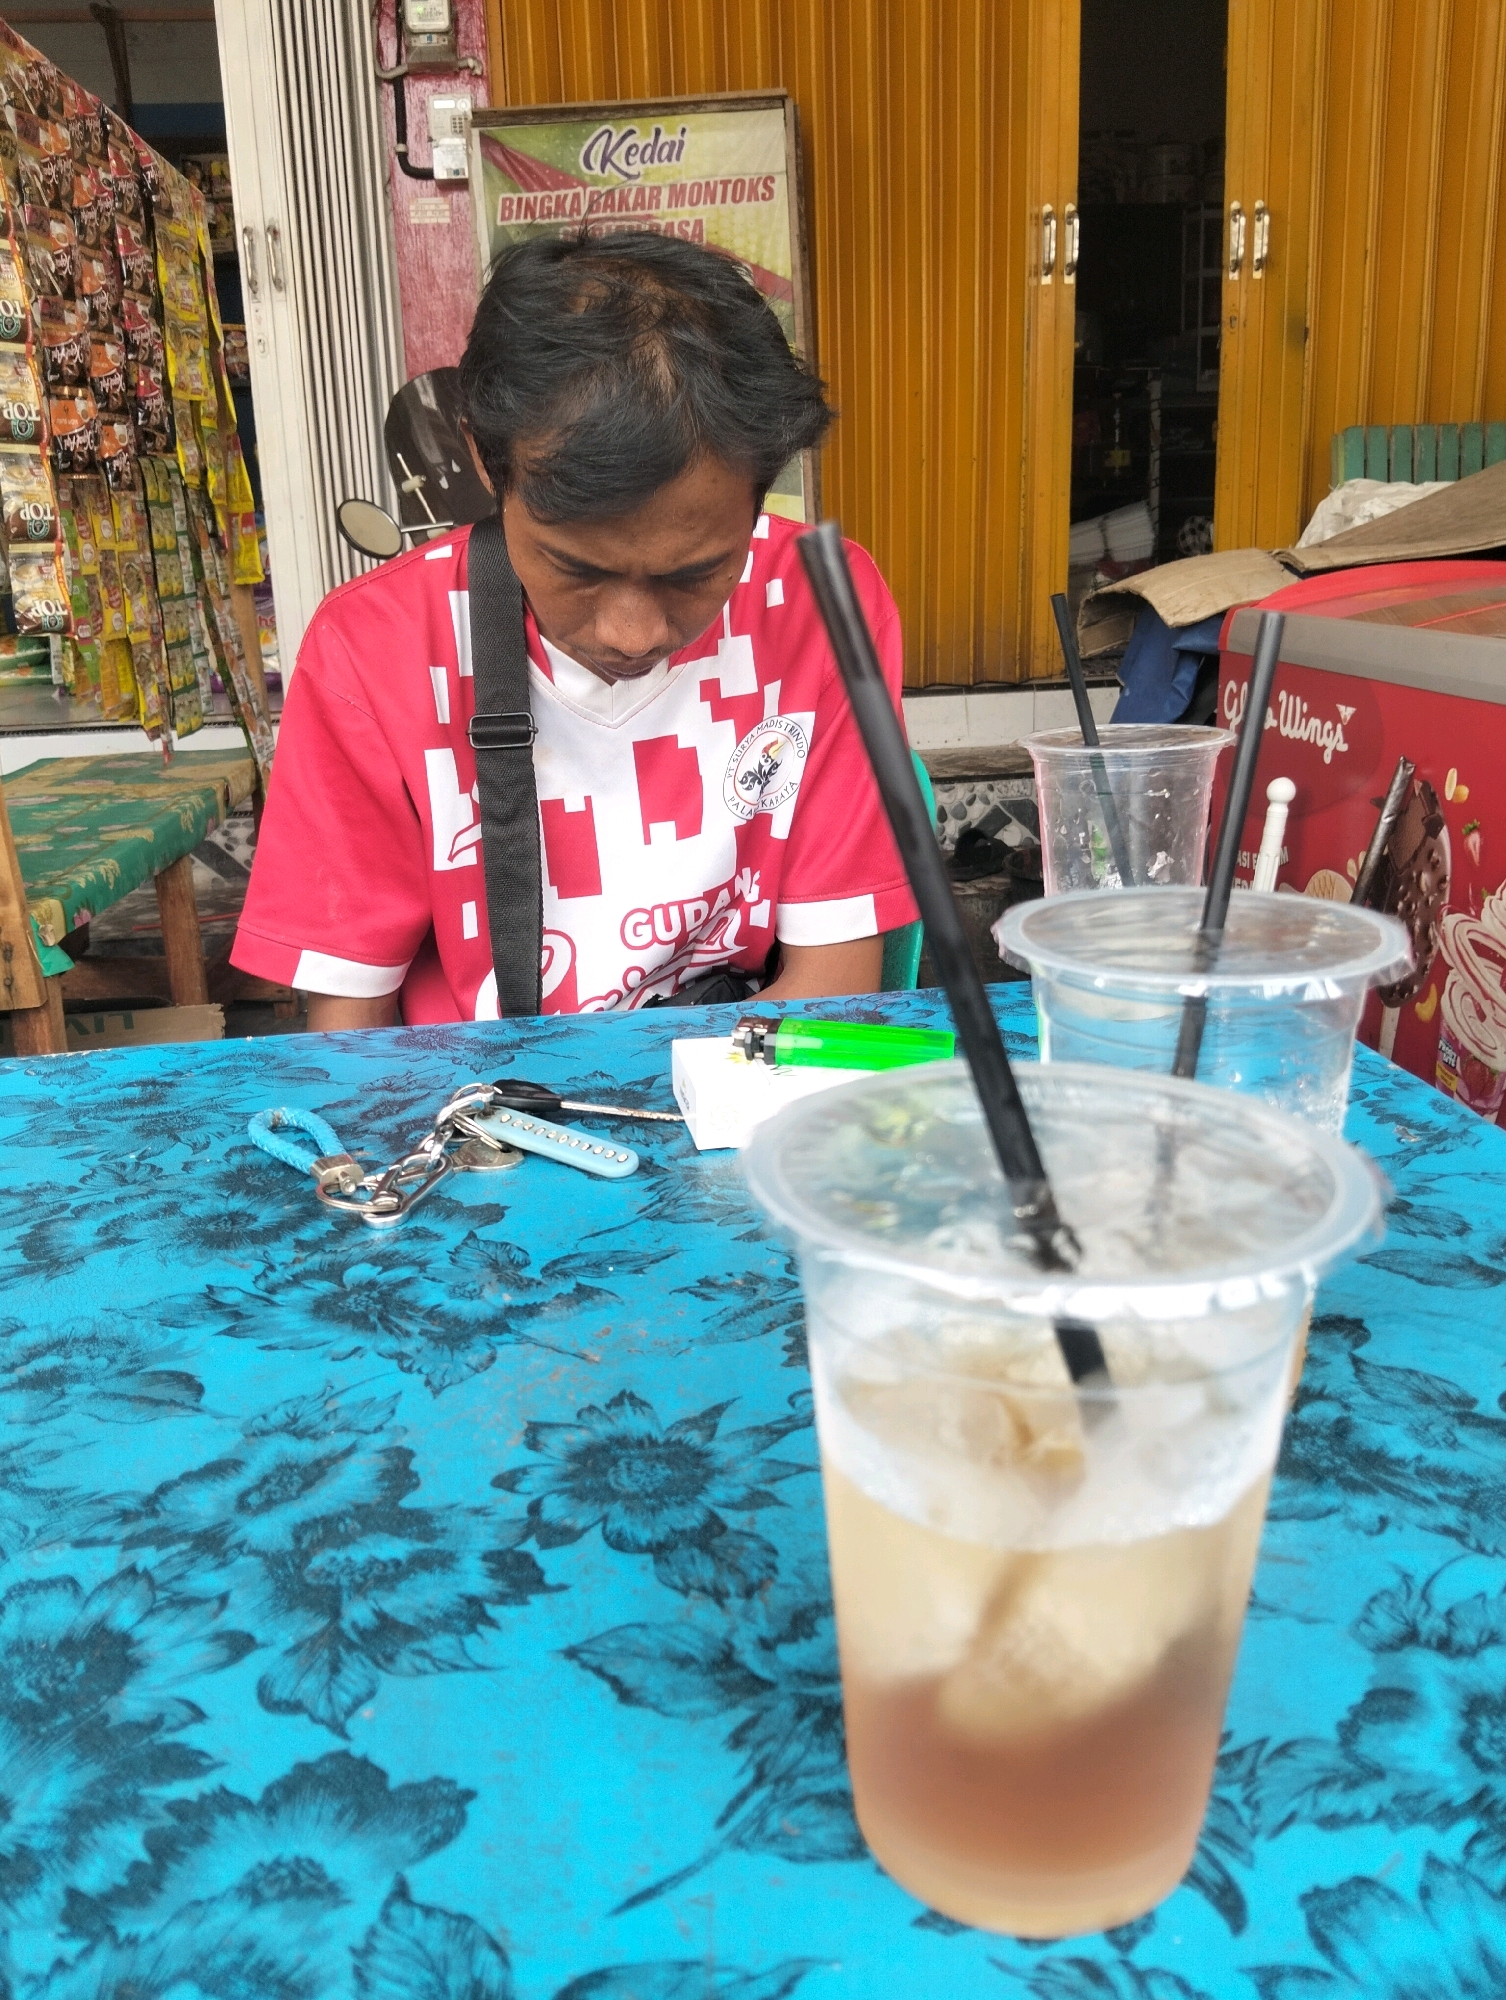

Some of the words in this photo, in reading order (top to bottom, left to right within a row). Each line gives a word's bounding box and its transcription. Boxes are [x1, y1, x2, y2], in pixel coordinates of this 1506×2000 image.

[582, 126, 687, 181] Kedai
[499, 193, 583, 223] BINGKA
[588, 186, 662, 215] BAKAR
[667, 175, 776, 209] MONTOKS
[0, 299, 26, 319] TO
[2, 401, 41, 421] TOP
[20, 502, 55, 521] TOP
[30, 599, 69, 618] TOP
[1279, 690, 1349, 765] Wings
